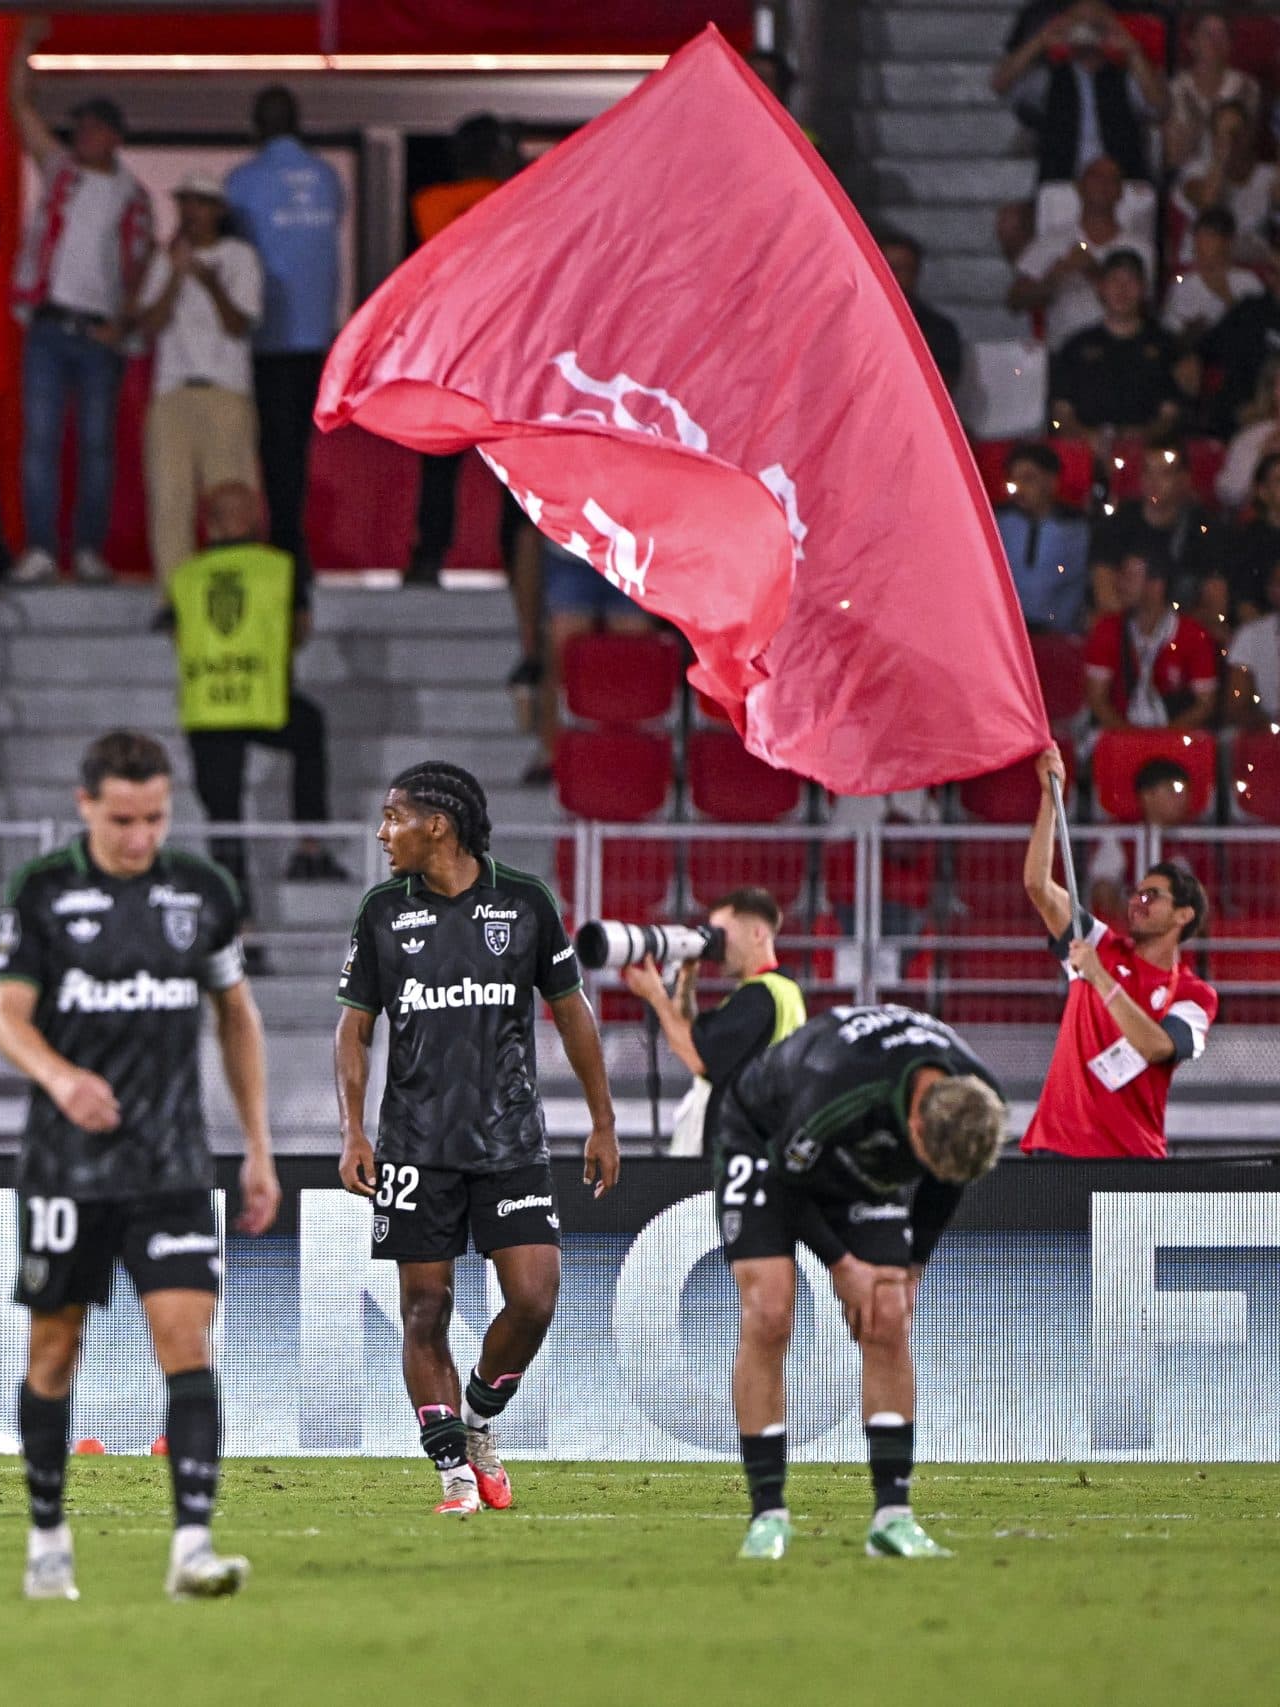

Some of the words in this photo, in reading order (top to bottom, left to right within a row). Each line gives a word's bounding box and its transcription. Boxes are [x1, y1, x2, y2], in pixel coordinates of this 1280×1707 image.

[471, 904, 518, 920] Nexans
[57, 967, 200, 1013] Auchan
[399, 976, 516, 1014] Auchan
[376, 1162, 419, 1211] 32
[28, 1196, 78, 1253] 10
